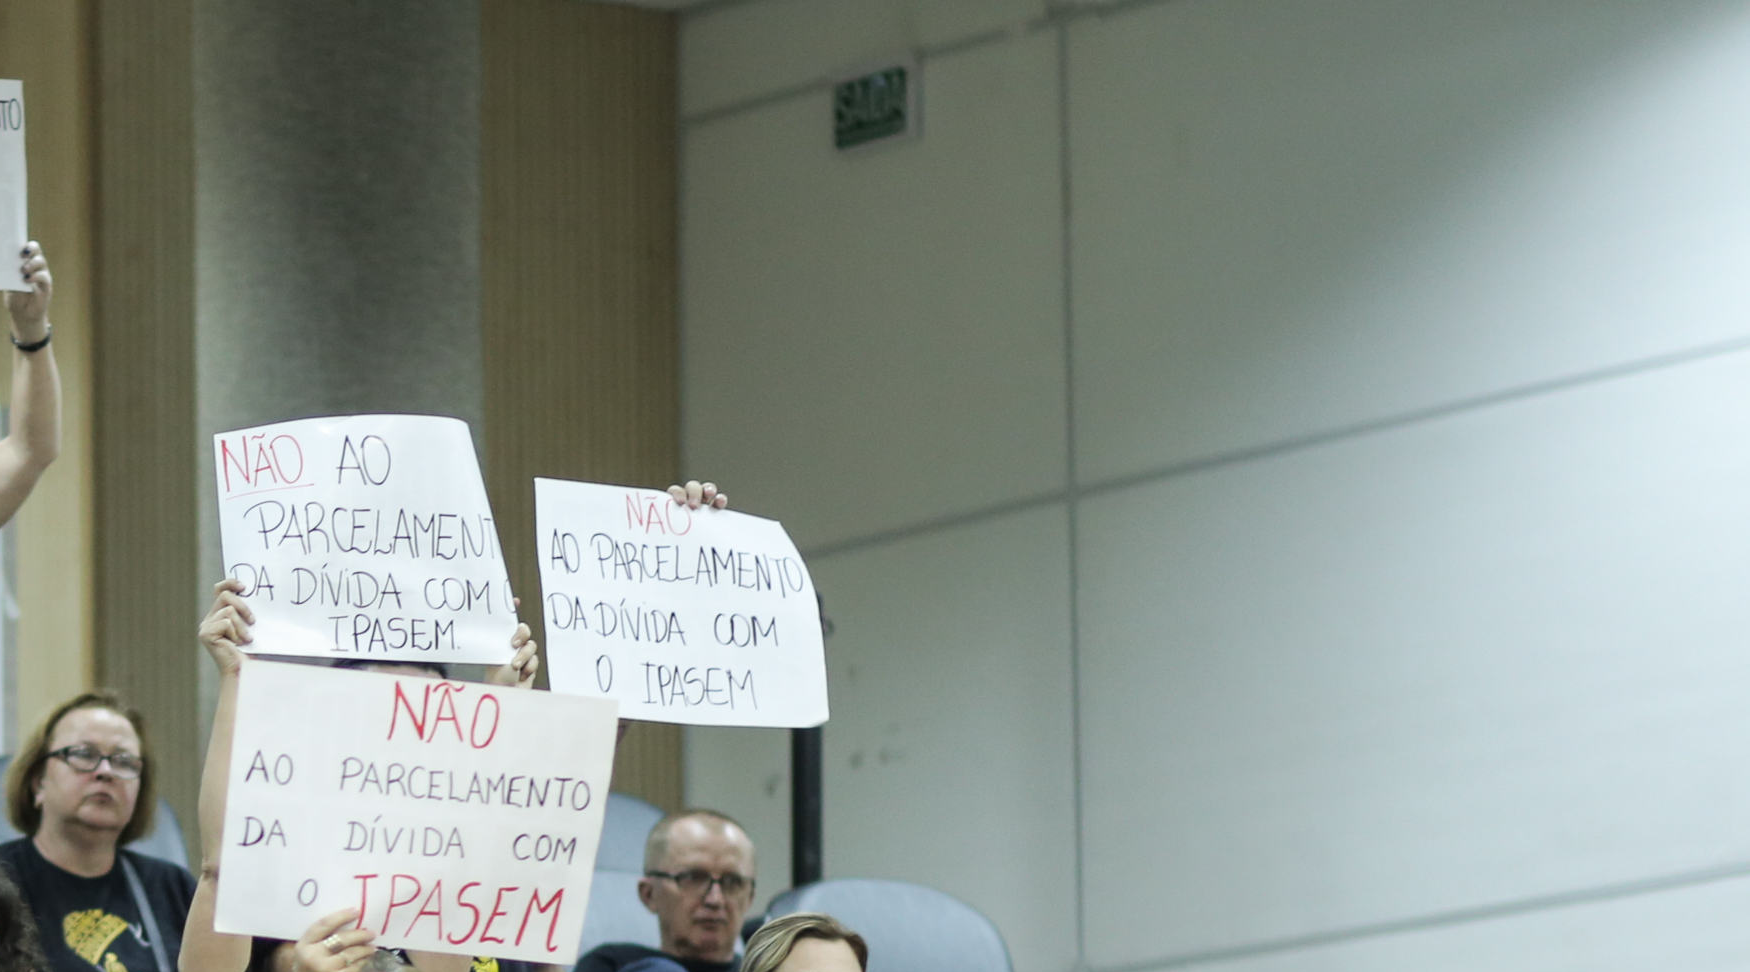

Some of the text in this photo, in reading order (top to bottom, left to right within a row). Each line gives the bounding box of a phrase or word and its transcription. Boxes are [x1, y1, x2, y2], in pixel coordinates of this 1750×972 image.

[220, 433, 392, 493] NÃO AO
[243, 500, 495, 560] PARCELAMENT
[625, 491, 692, 536] NÃO
[229, 563, 275, 601] DA
[290, 562, 402, 610] DÍVIDA
[424, 577, 492, 615] COM
[551, 528, 804, 598] AO PARCELAMENTO
[547, 592, 779, 648] DA DÍVIDA COM
[596, 654, 758, 710] O IPASEM
[386, 681, 501, 750] NÃO
[244, 749, 591, 812] AO PARCELAMENTO
[237, 815, 578, 865] DA DÍVIDA COM
[297, 873, 565, 953] O IPASEM
